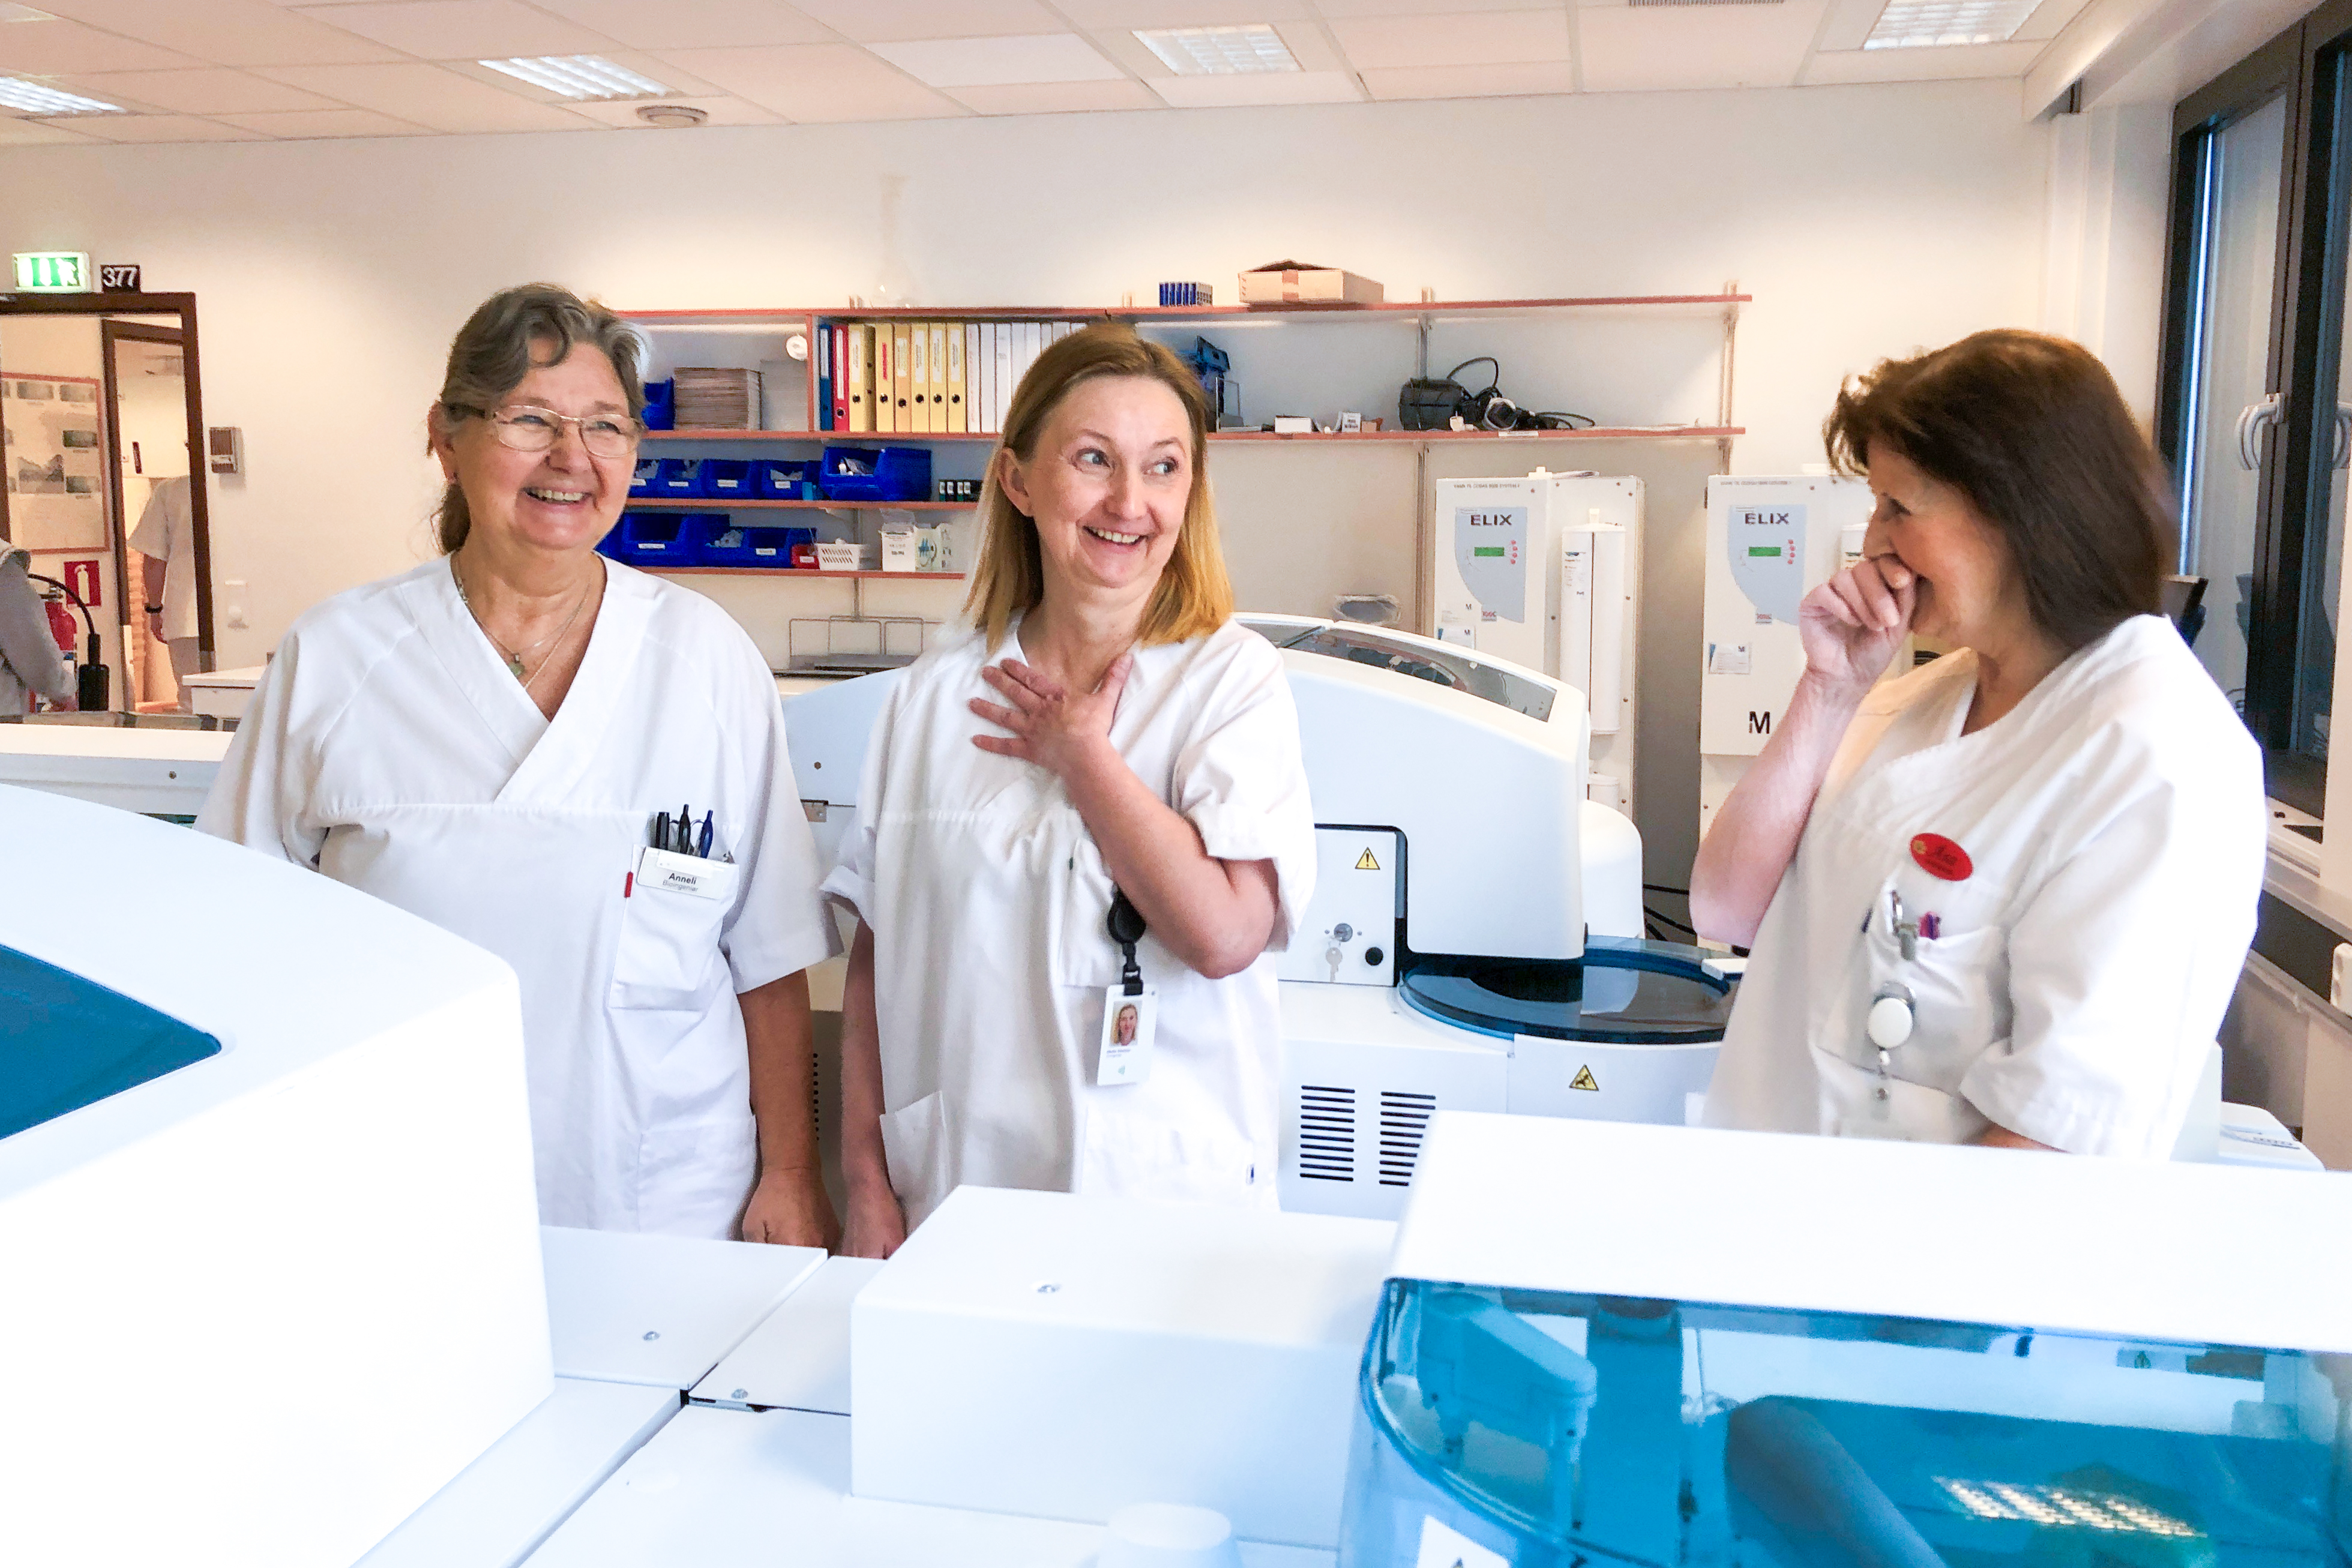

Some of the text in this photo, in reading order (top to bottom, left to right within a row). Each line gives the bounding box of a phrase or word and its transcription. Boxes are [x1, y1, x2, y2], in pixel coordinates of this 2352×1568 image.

[103, 267, 137, 288] 377
[1470, 514, 1512, 526] ELIX
[1744, 512, 1789, 524] ELIX
[1749, 710, 1770, 734] M
[668, 873, 697, 885] Anneli
